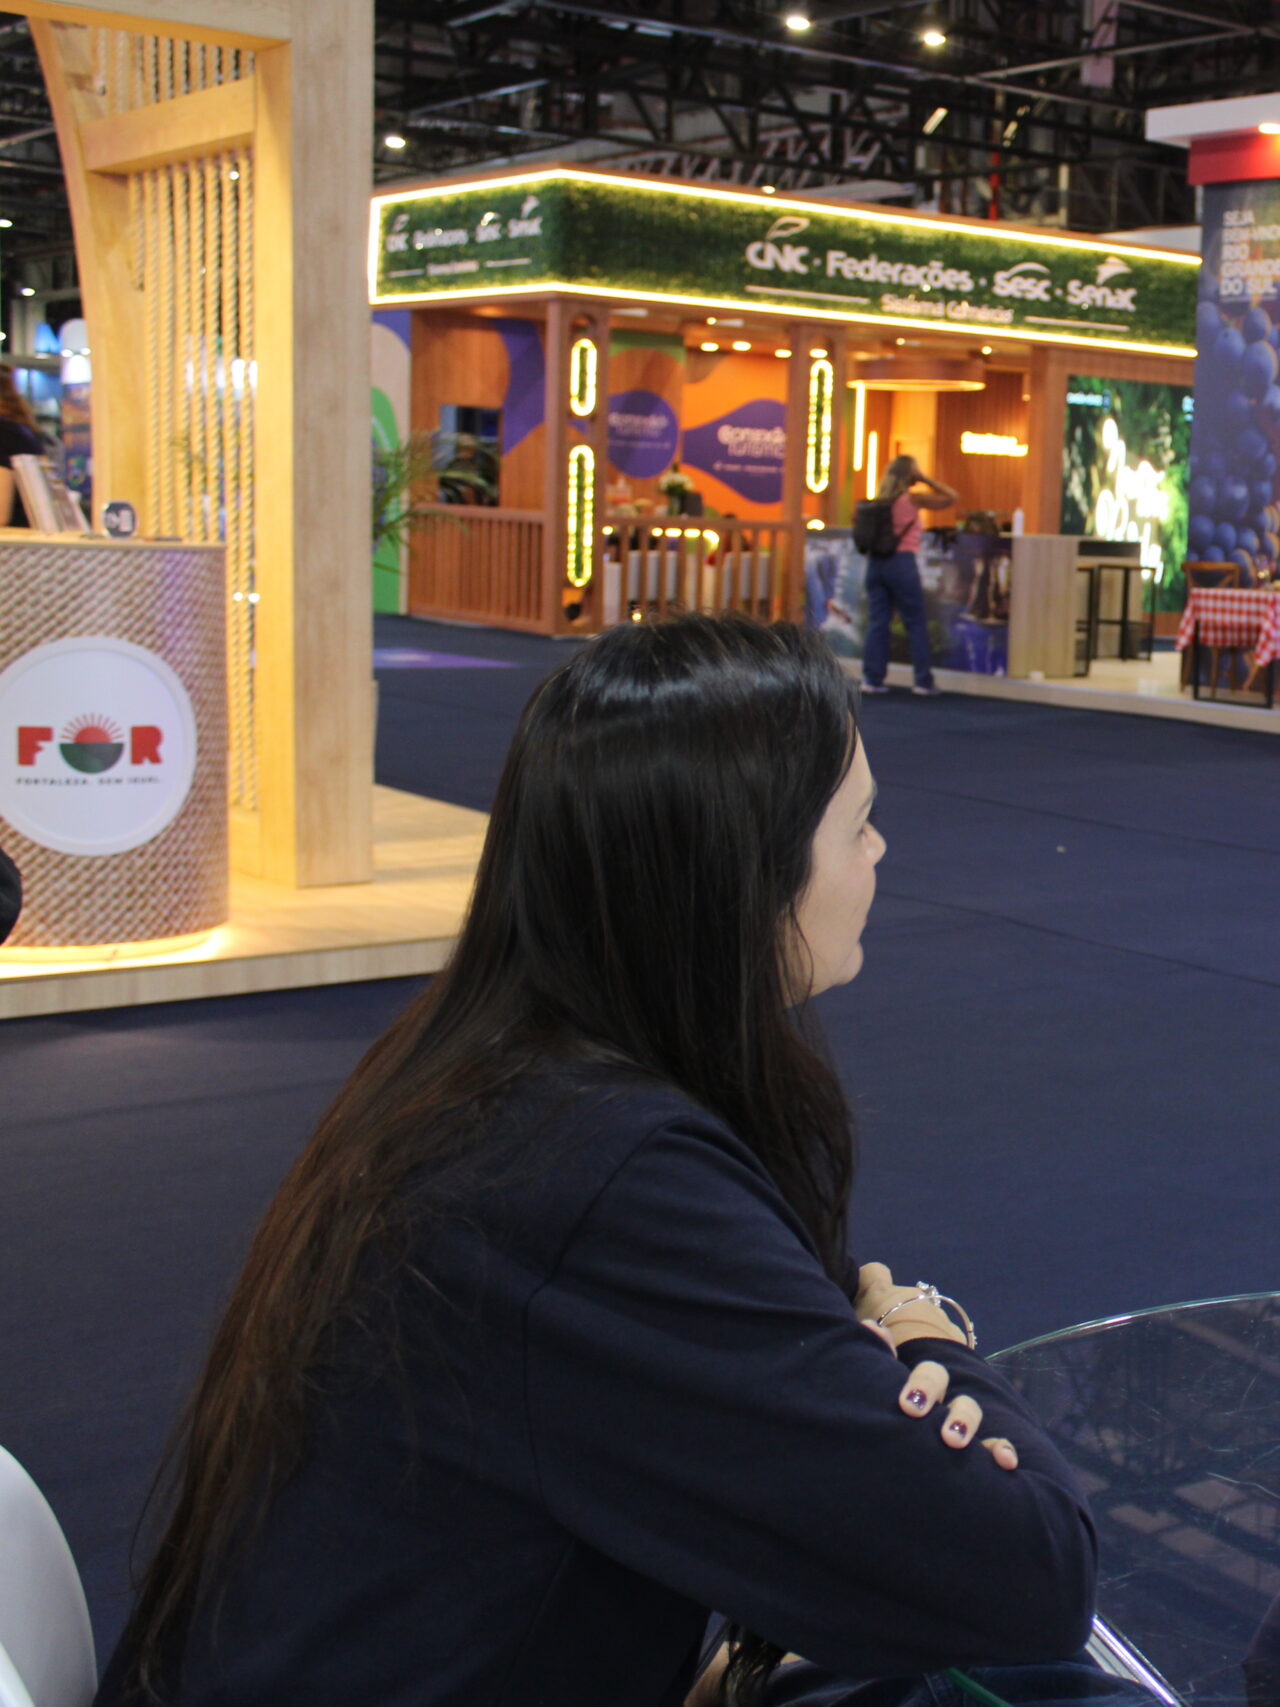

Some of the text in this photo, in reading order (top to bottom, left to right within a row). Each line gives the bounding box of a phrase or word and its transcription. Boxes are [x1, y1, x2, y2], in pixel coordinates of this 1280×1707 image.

[1223, 210, 1255, 226] SEJA
[1222, 244, 1249, 260] RIO
[745, 241, 1137, 312] CNC Federações Sesc Senac
[1220, 279, 1243, 296] DO
[1245, 278, 1278, 295] SUL
[17, 713, 163, 774] FOR
